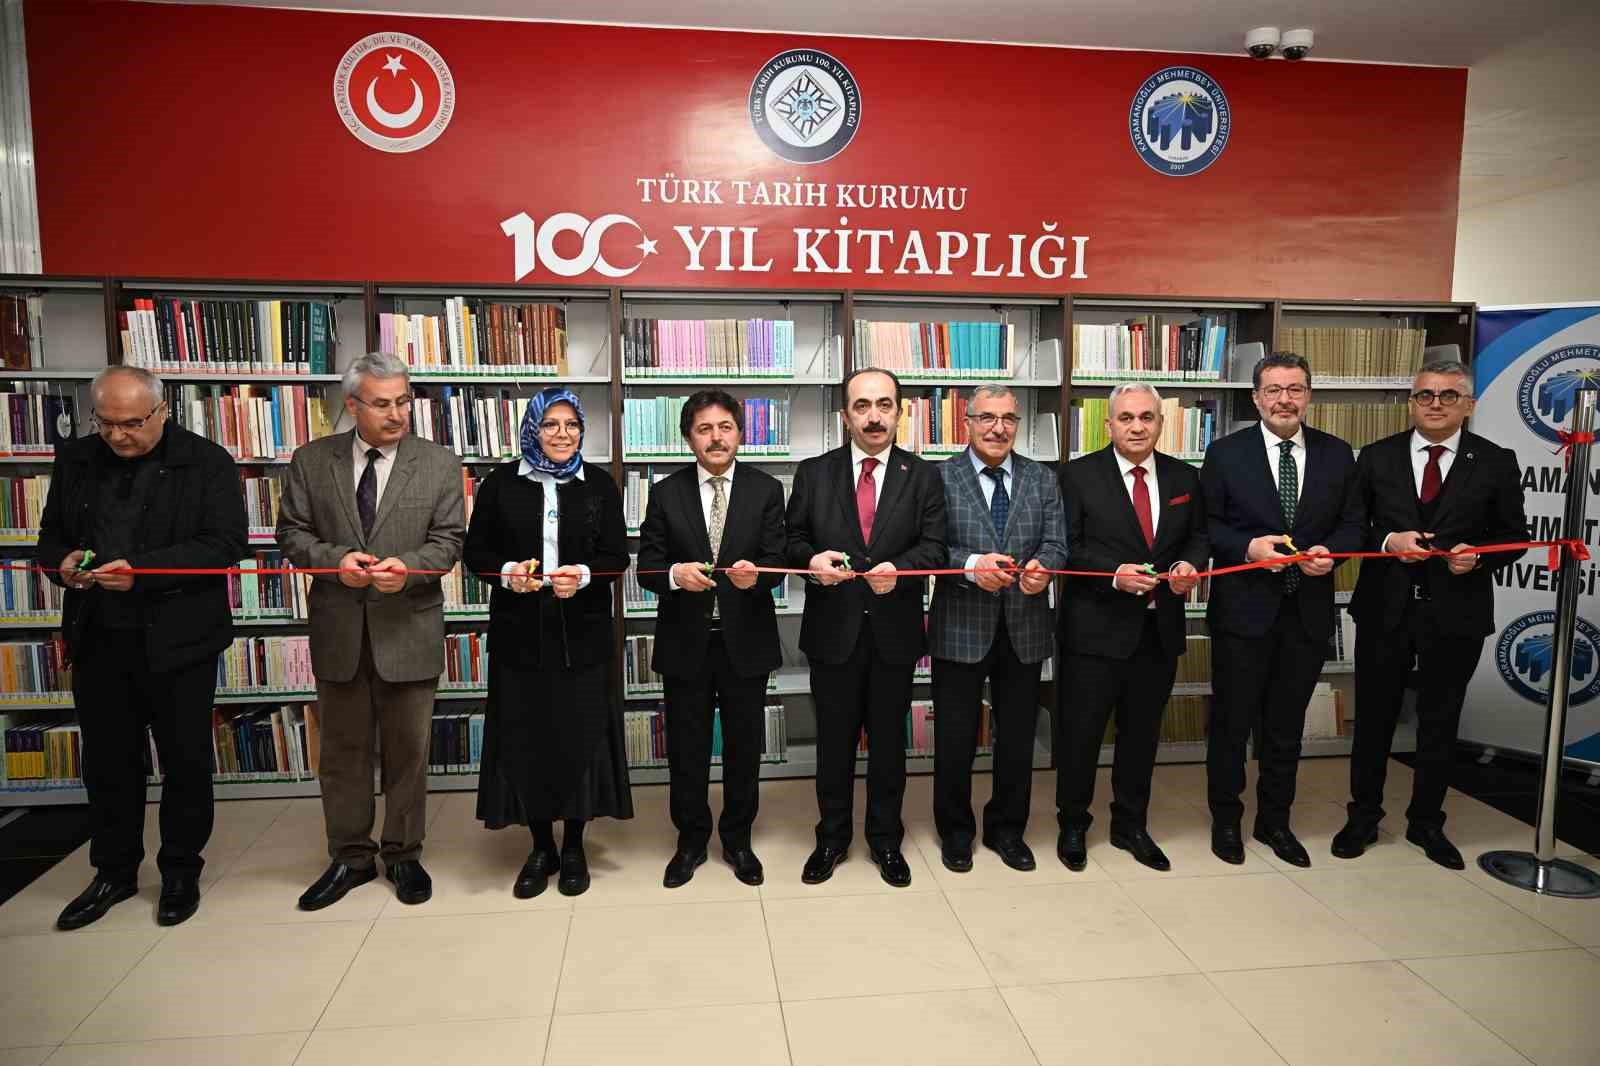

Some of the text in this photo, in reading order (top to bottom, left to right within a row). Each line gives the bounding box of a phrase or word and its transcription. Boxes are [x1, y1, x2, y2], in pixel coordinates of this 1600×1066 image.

[773, 54, 814, 71] KURUMU
[832, 66, 845, 80] YIL
[756, 69, 775, 95] TARİH
[752, 96, 764, 122] TÜRK
[1132, 69, 1229, 156] KARAMANOĞLU MEHMETBEY ÜNİVERSİTESİ
[636, 175, 968, 212] TÜRK TARİH KURUMU
[674, 225, 775, 273] YIL
[793, 215, 1091, 280] KİTAPLIĞI
[1550, 347, 1600, 362] MEHMET
